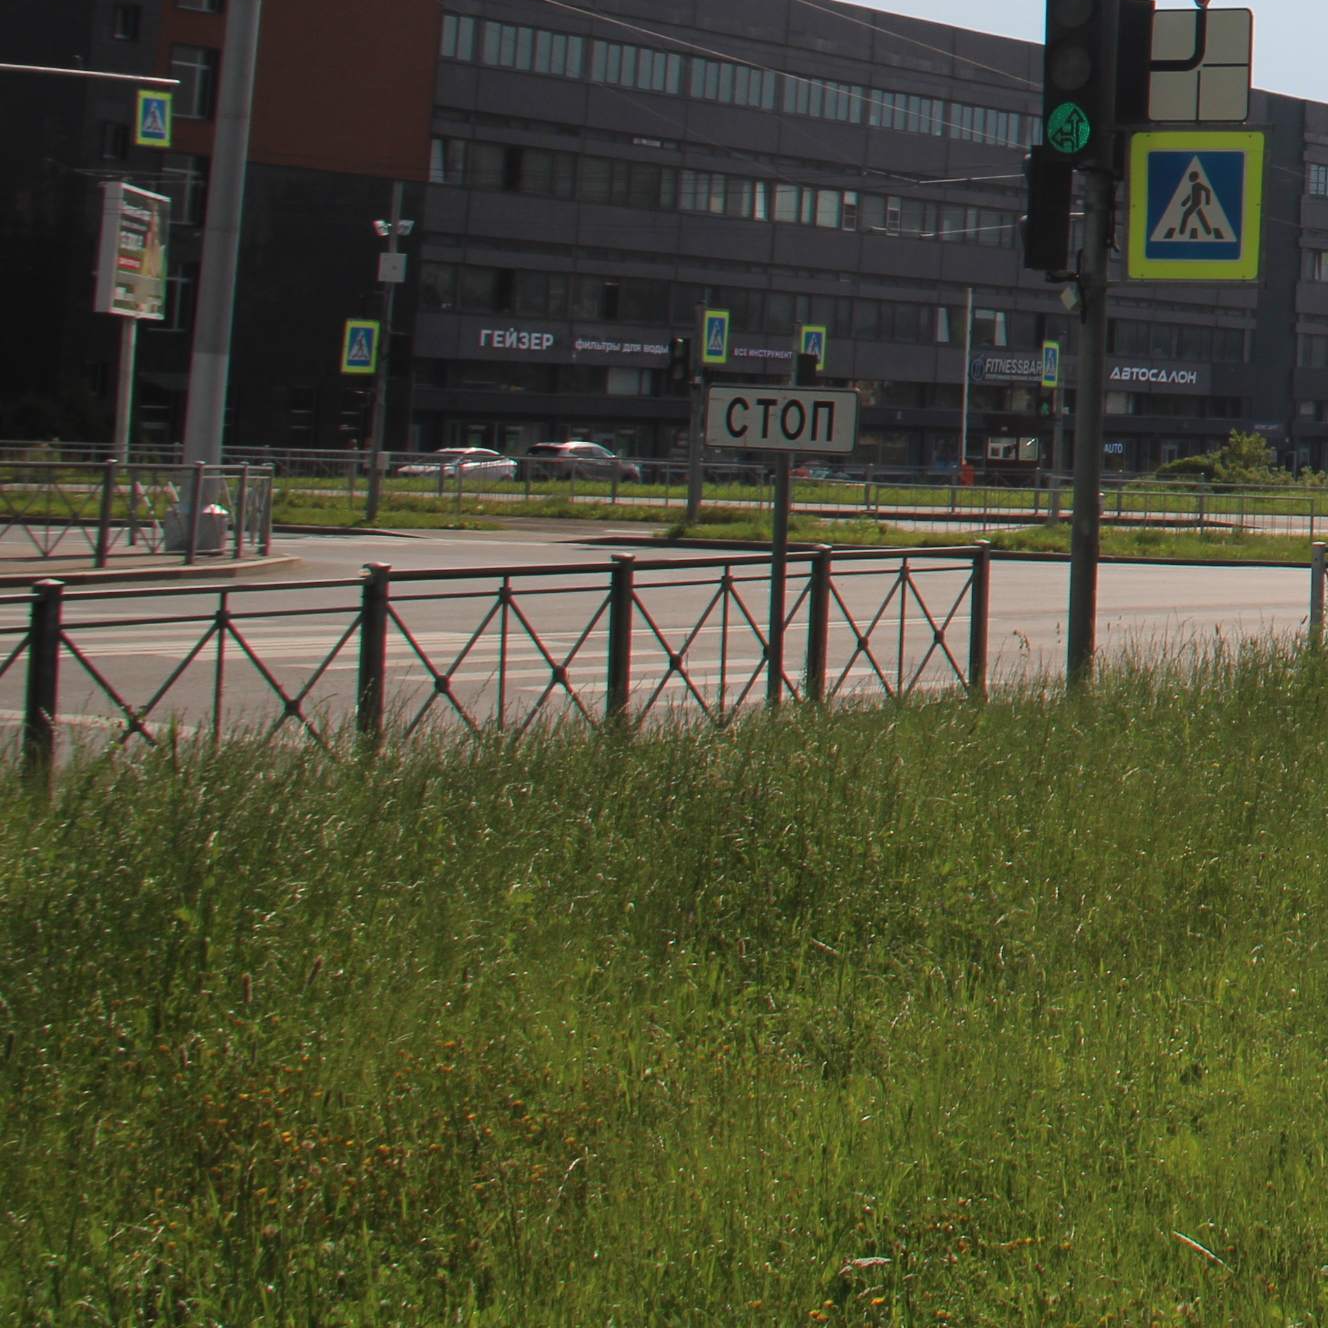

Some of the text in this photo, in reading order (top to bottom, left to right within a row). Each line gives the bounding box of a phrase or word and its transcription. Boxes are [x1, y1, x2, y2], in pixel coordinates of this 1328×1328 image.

[479, 328, 554, 350] ГЕЙЗЕР
[575, 338, 669, 354] фильтры для воды
[1110, 366, 1197, 384] АВТОСАЛОН
[726, 397, 835, 441] СТОП
[1104, 443, 1123, 454] AUTO
